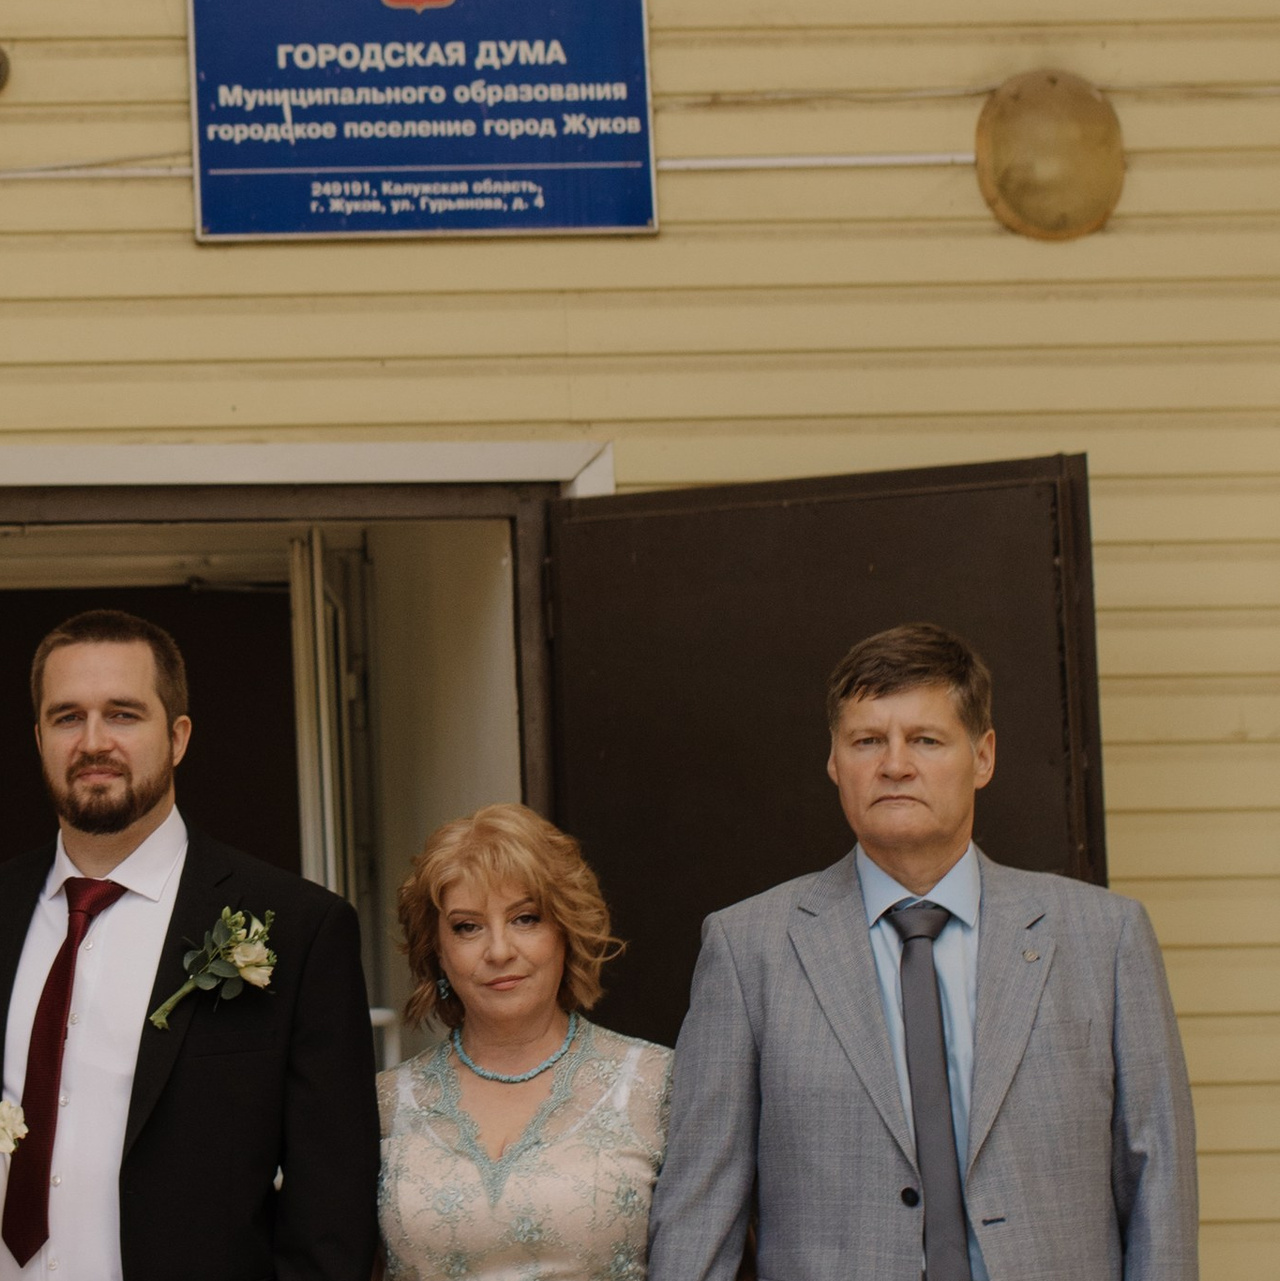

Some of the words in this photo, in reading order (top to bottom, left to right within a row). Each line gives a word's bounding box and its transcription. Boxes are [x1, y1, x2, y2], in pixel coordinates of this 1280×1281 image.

[277, 40, 467, 73] ГОРОДСКАЯ
[474, 39, 567, 71] ДУМА
[218, 84, 447, 109] Муниципального
[453, 79, 628, 107] образования
[206, 119, 337, 143] городское
[343, 119, 477, 139] поселение
[483, 117, 558, 139] город
[562, 113, 642, 139] Жуков
